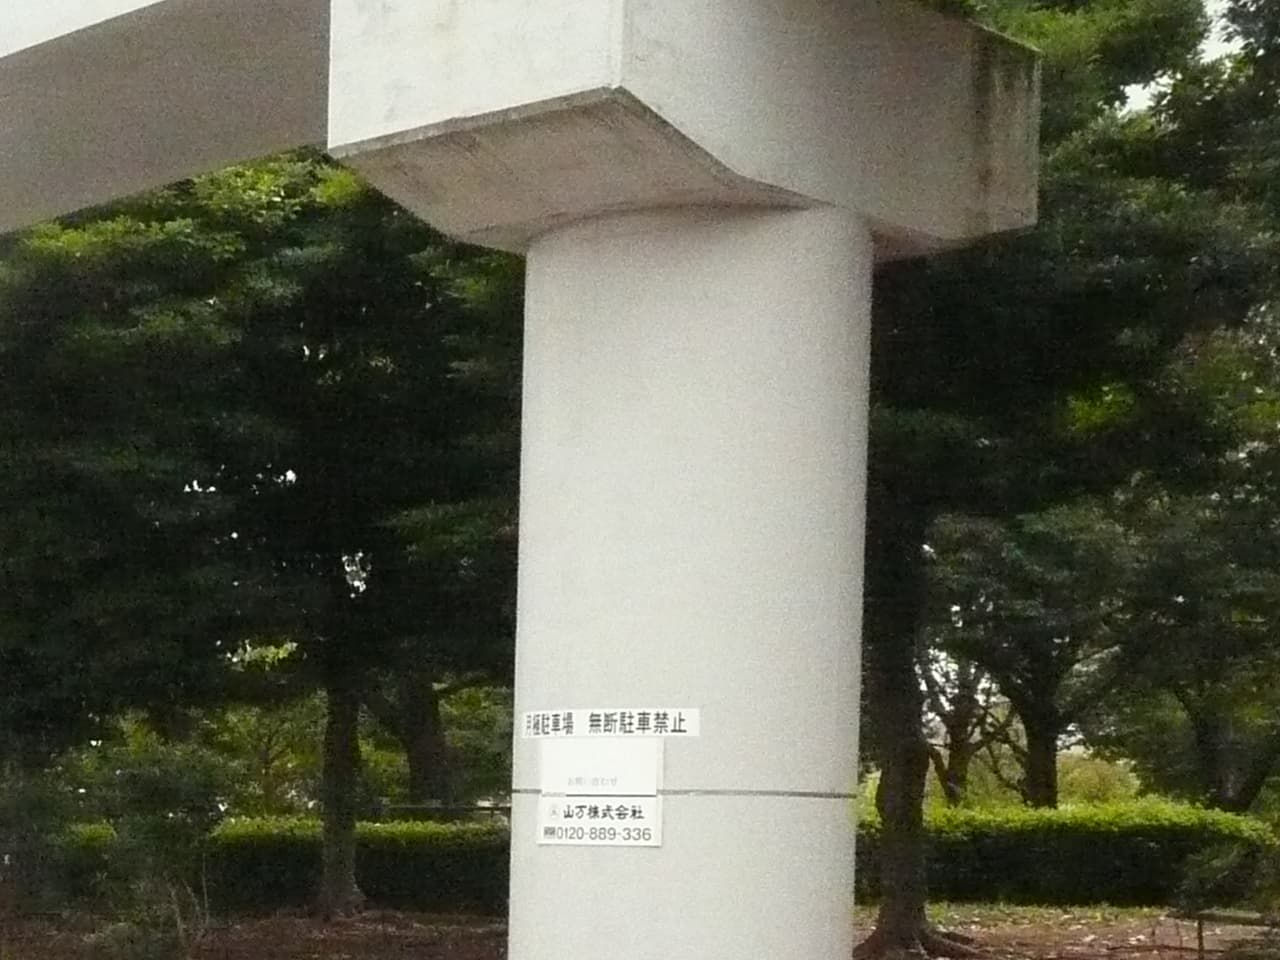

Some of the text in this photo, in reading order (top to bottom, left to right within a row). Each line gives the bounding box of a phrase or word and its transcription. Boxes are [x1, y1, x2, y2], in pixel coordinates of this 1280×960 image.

[588, 711, 687, 735] 無断駐車禁止
[563, 804, 645, 821] 山万株式会社
[557, 826, 652, 841] 0120-889-336
